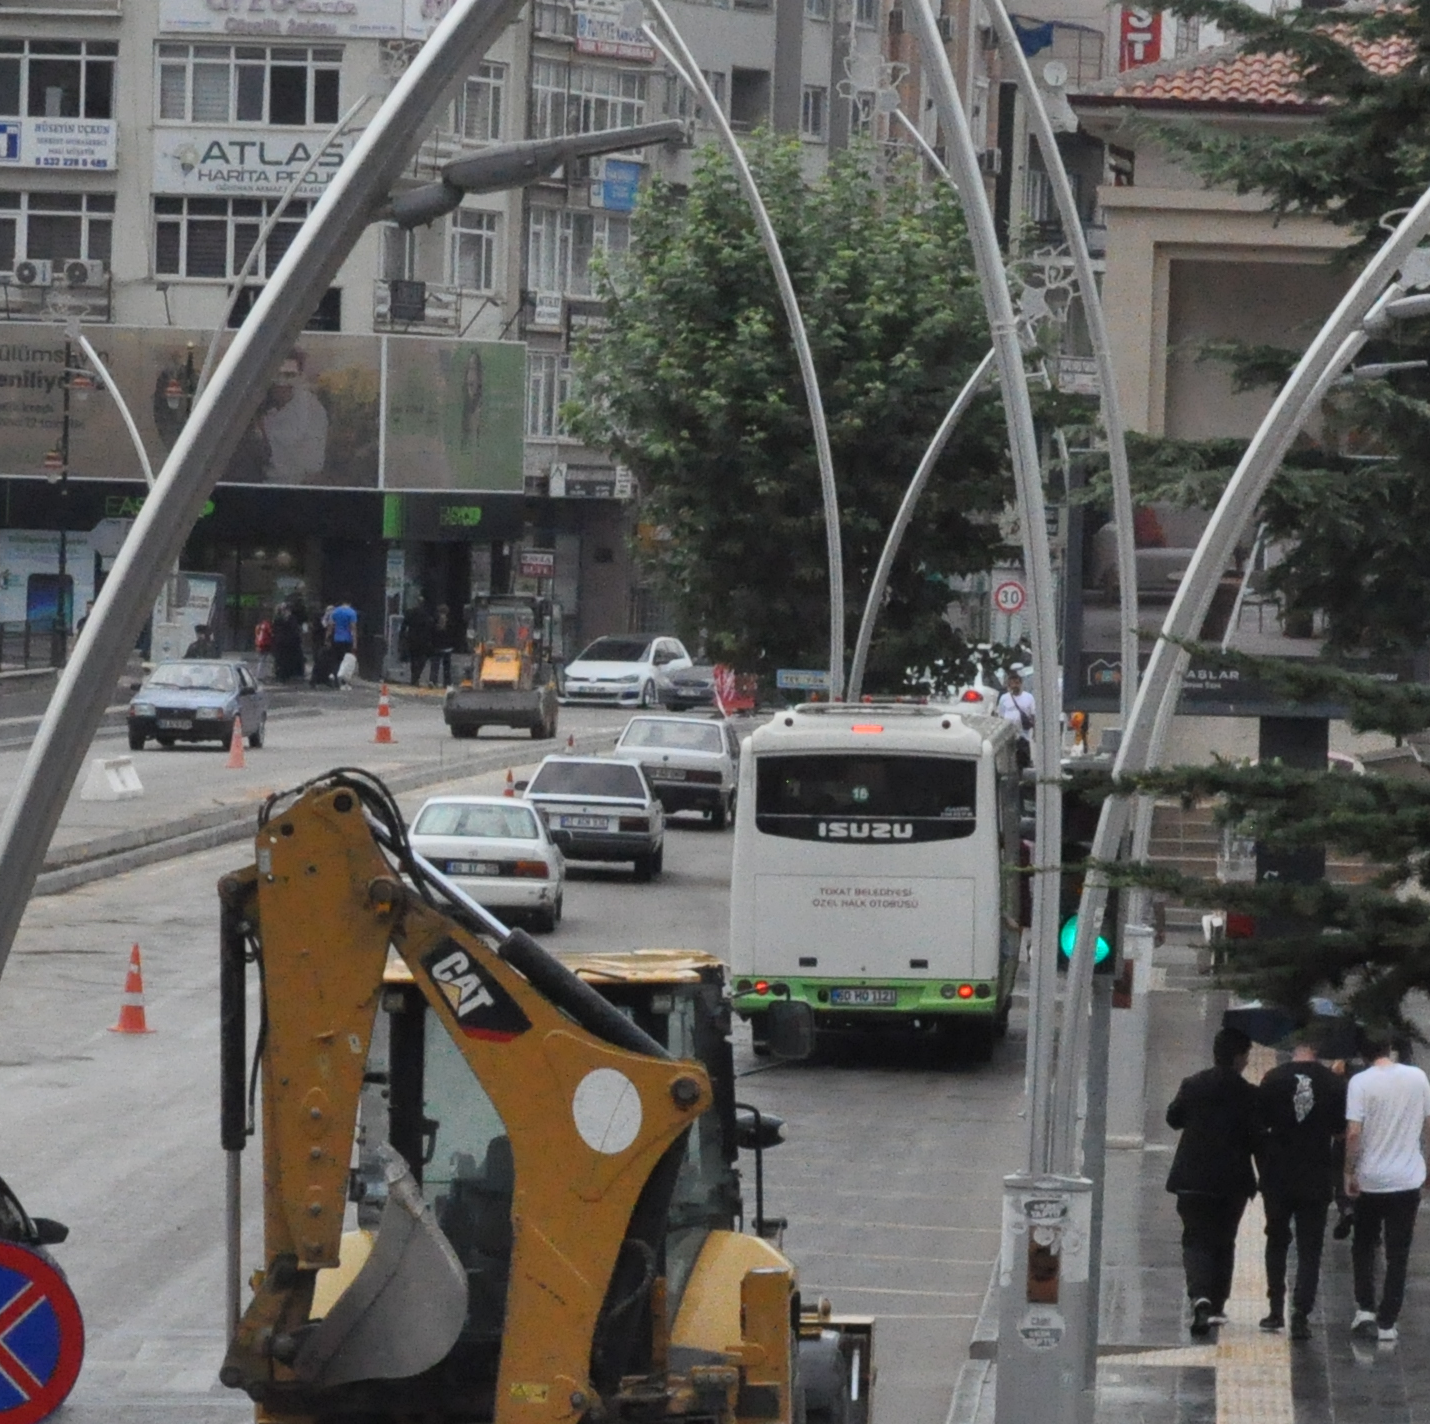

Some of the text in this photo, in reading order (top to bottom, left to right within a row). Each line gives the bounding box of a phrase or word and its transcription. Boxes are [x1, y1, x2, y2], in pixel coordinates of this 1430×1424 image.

[200, 140, 344, 167] ATLAS
[197, 166, 270, 183] HARİTA
[1001, 590, 1019, 604] 30
[818, 822, 913, 839] ISUZU
[821, 887, 851, 897] TOKAT
[431, 951, 494, 1017] CAT
